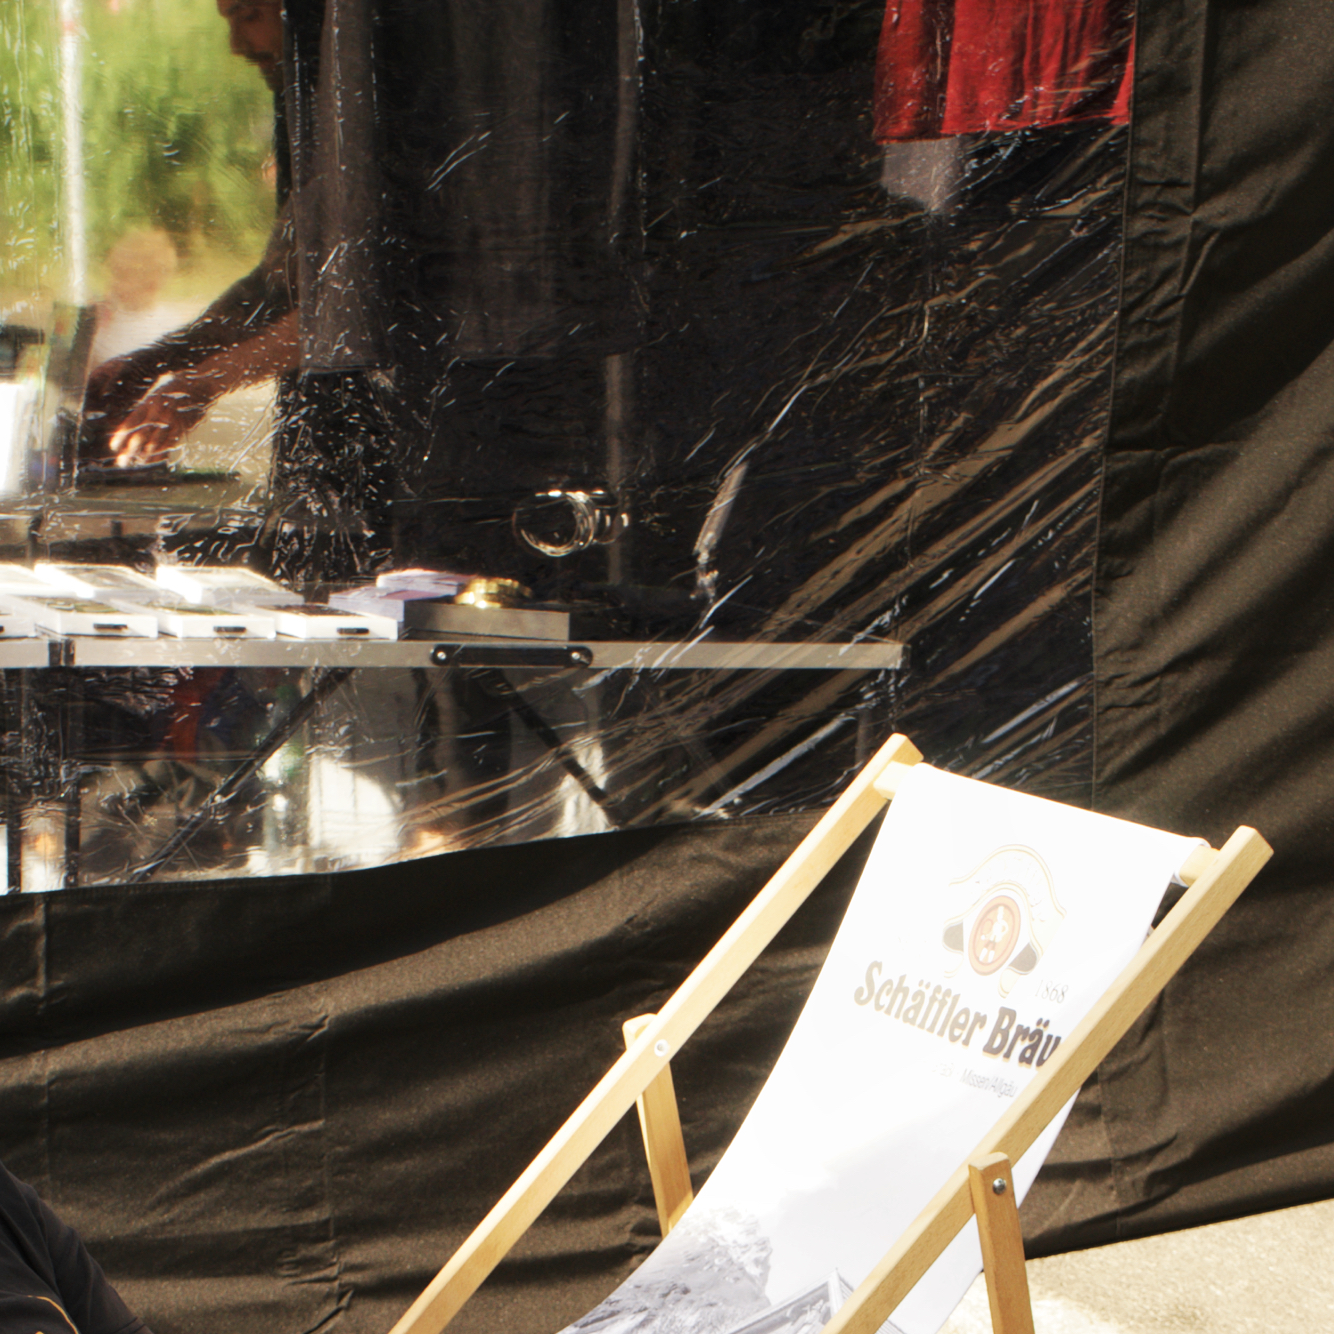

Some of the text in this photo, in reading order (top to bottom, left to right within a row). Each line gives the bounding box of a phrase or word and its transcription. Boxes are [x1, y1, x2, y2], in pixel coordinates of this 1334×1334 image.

[853, 960, 1062, 1071] Schäffler Bräu
[1034, 979, 1069, 1005] 1868
